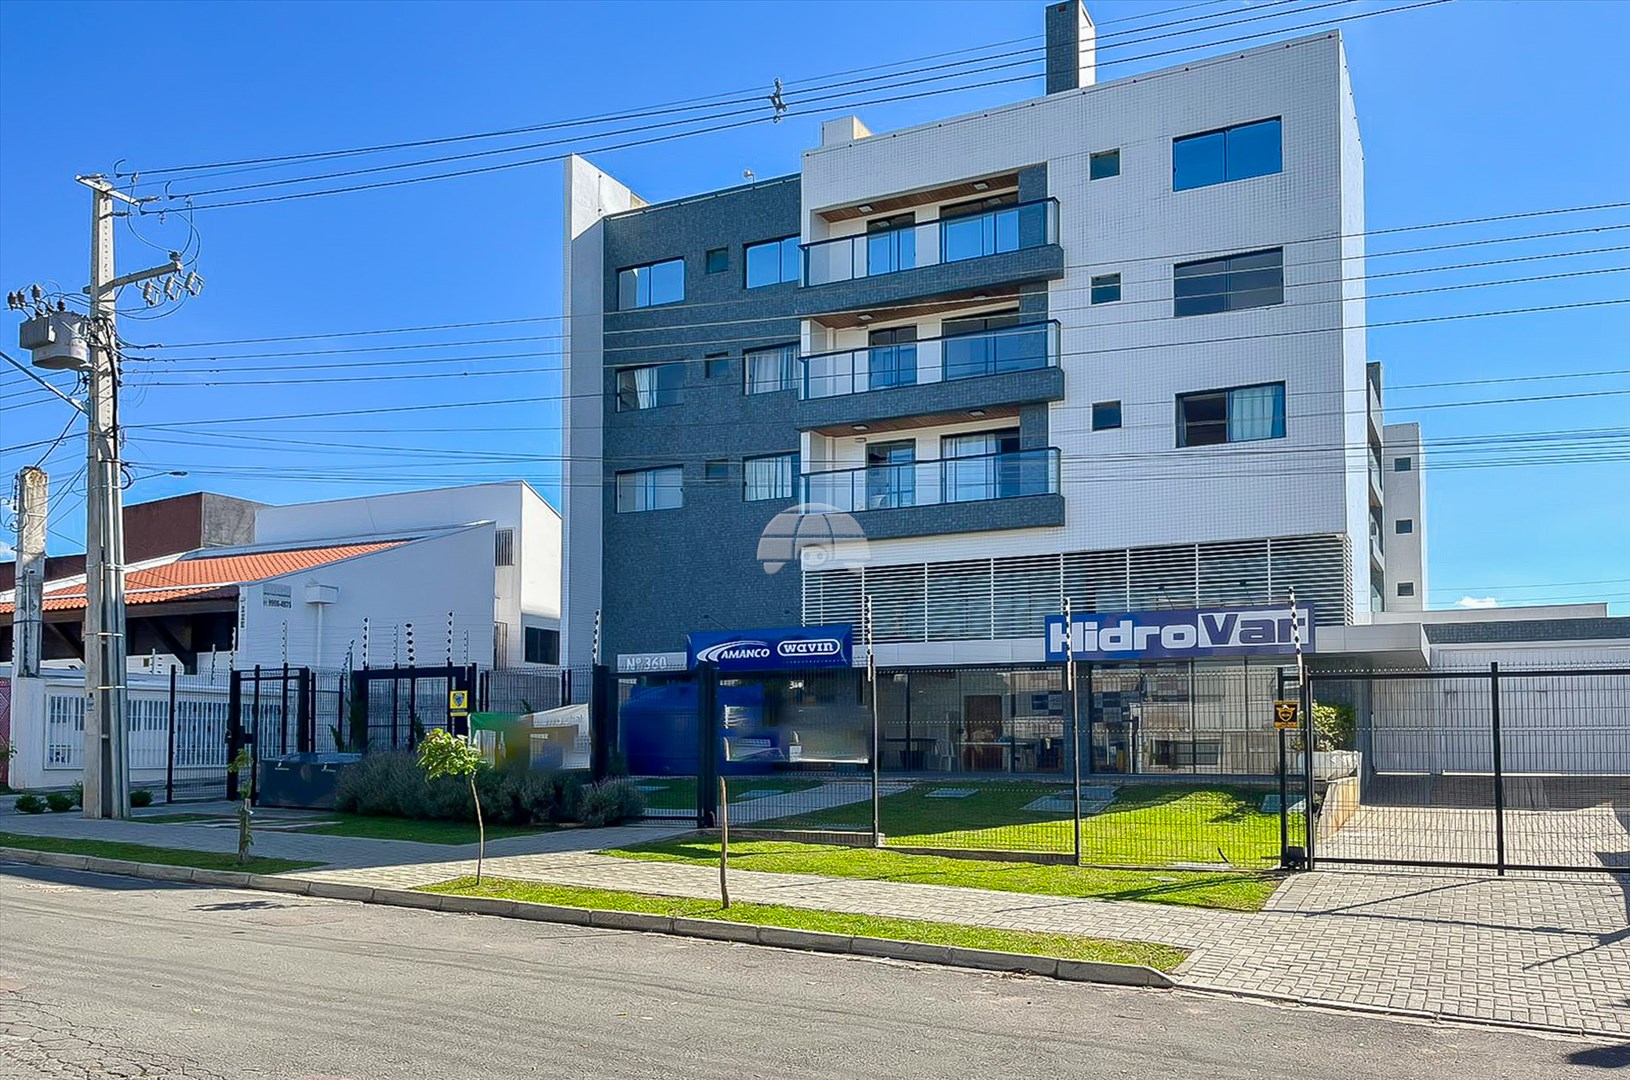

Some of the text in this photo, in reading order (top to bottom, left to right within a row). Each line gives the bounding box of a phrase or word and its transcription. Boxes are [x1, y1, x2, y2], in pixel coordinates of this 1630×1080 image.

[1049, 608, 1308, 653] HidroVar
[721, 642, 834, 660] AMANCO wavin
[643, 656, 667, 670] 360
